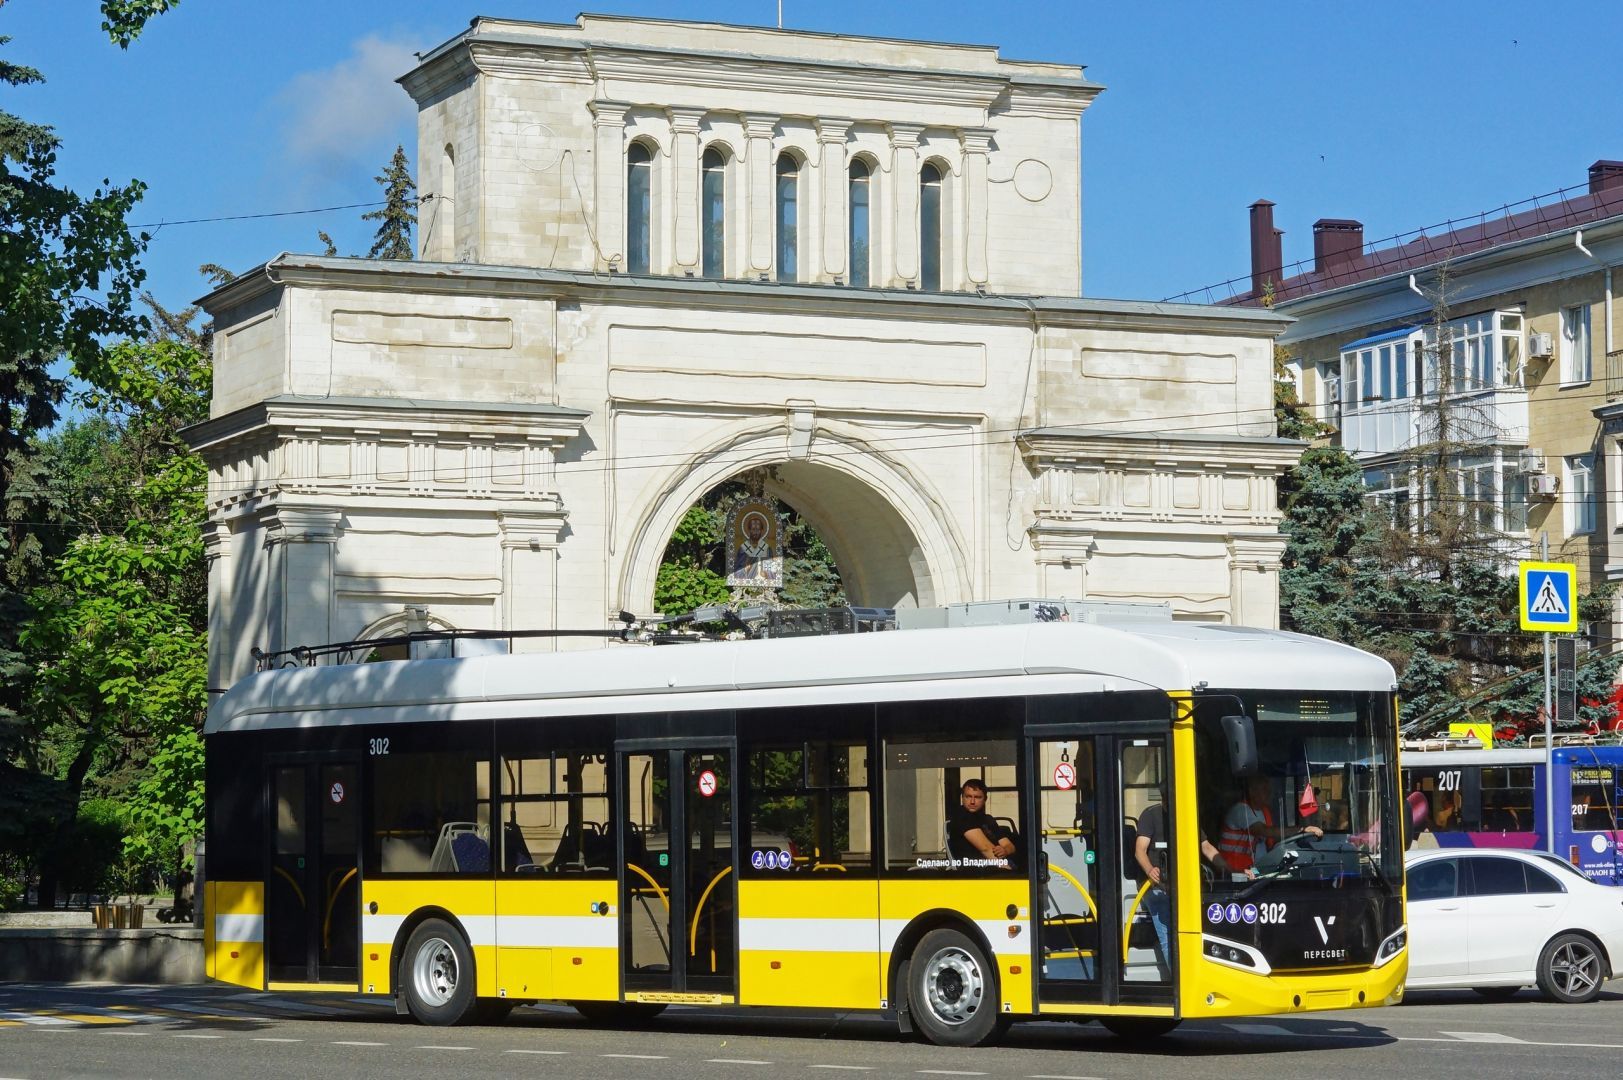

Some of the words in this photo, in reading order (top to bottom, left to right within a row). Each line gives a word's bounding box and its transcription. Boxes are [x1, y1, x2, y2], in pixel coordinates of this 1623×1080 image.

[369, 737, 390, 755] 302
[1438, 770, 1461, 791] 207
[1571, 804, 1589, 815] 207
[916, 857, 950, 868] Сделано
[951, 859, 962, 867] во
[963, 857, 1008, 868] Владимире
[1260, 902, 1287, 924] 302
[1304, 949, 1345, 959] ПЕРЕСВЕТ
